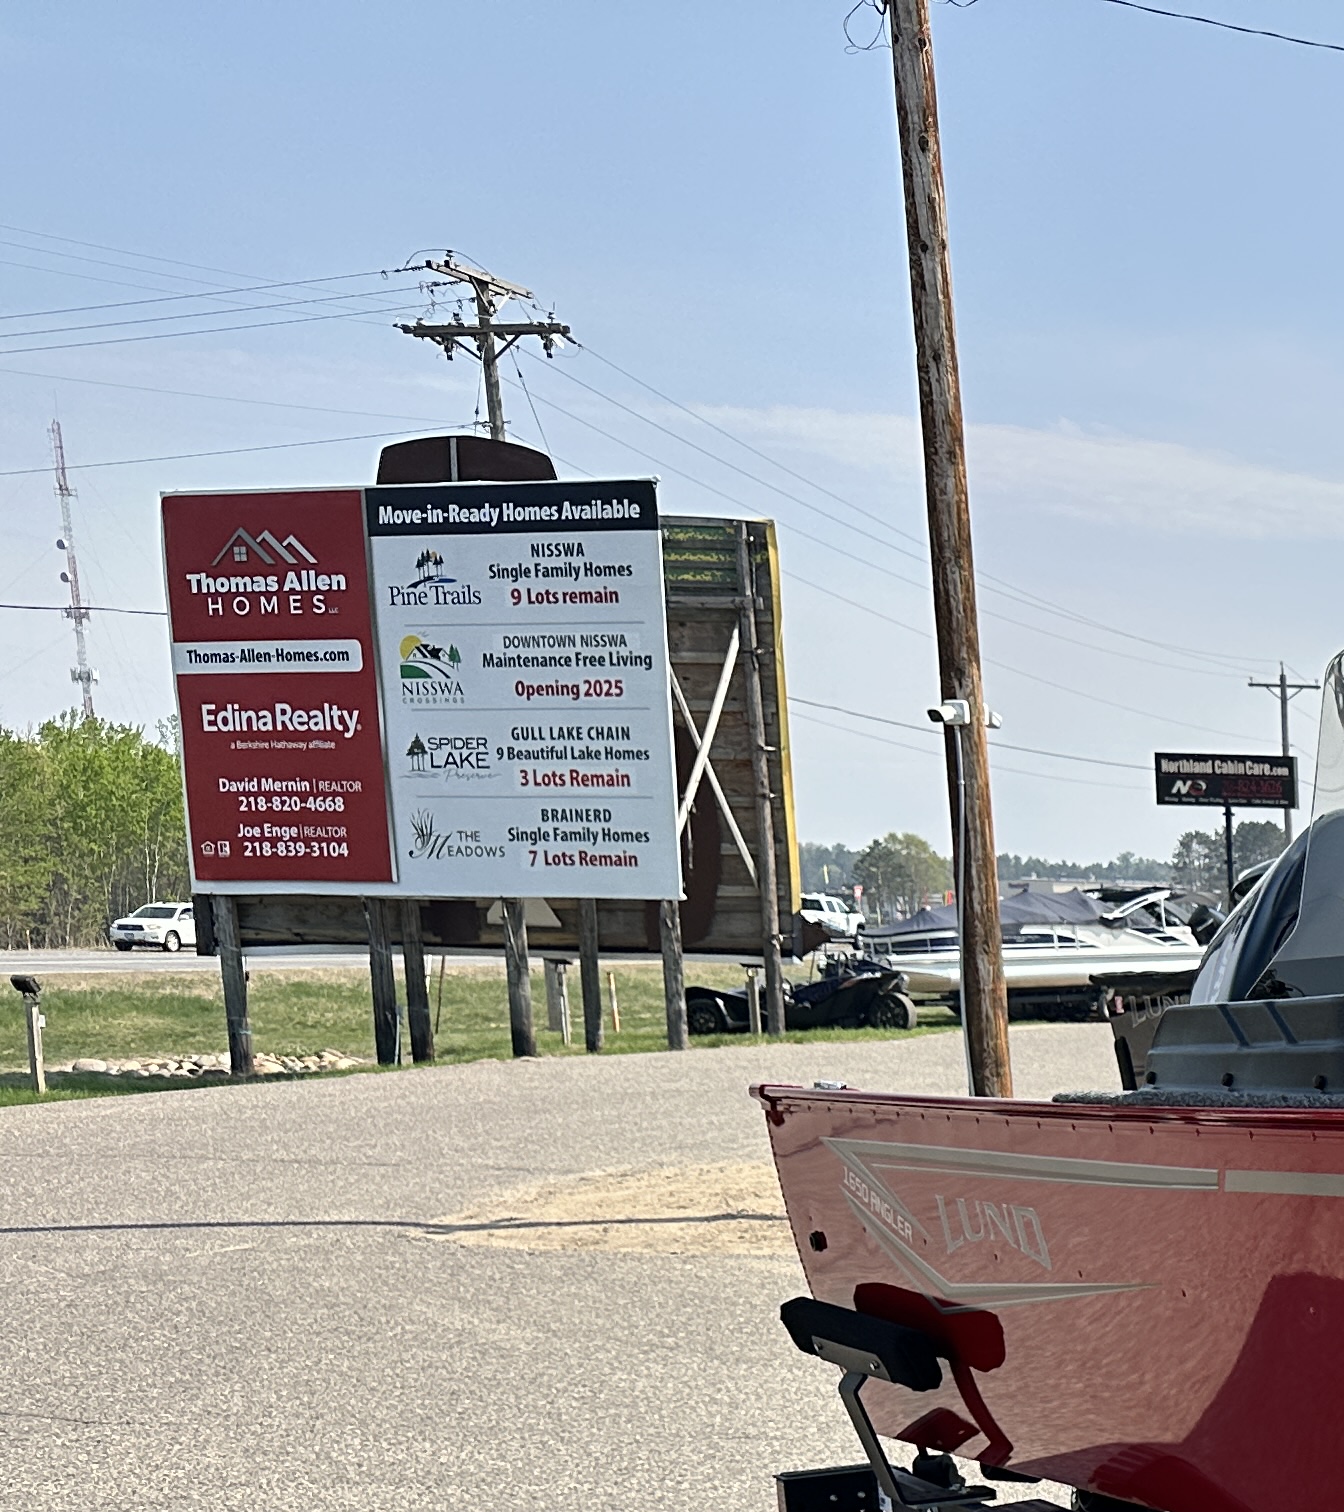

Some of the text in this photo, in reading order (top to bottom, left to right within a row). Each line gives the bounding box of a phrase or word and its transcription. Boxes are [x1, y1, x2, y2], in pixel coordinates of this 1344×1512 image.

[378, 499, 641, 527] Move-in-Ready Homes Available
[530, 542, 585, 558] NISSWA
[488, 562, 633, 583] Single Family Homes
[186, 570, 347, 594] Thomas Allen
[388, 584, 482, 606] Pine Trails
[510, 586, 620, 606] 9 Lots remain
[207, 594, 327, 616] HOMES
[503, 634, 628, 649] DOWNTOWN NISSWA
[186, 648, 350, 664] Thomas-Allen-Homes.com
[482, 651, 653, 671] Maintenance Free Living
[402, 681, 465, 696] NISSWA
[515, 679, 624, 701] Opening 2025
[511, 726, 631, 741] GULL LAKE CHAIN
[427, 737, 488, 751] SPIDER
[430, 752, 490, 769] LAKE
[496, 746, 650, 761] 9 Beautiful Lake Homes
[1160, 758, 1213, 774] Northland
[1214, 759, 1245, 775] Cabin
[218, 777, 362, 793] David Mernin REALTOR
[519, 768, 631, 787] 3 Lots Remain
[238, 796, 345, 812] 218-820-4668
[541, 808, 612, 823] BRAINERD
[237, 823, 261, 838] Joe
[456, 830, 481, 842] THE
[507, 827, 650, 846] Single Family Homes
[243, 841, 349, 857] 218-839-3104
[528, 850, 638, 868] 7 Lots Remain
[842, 1165, 913, 1244] 1650 ANGLER
[934, 1193, 1053, 1271] LUND
